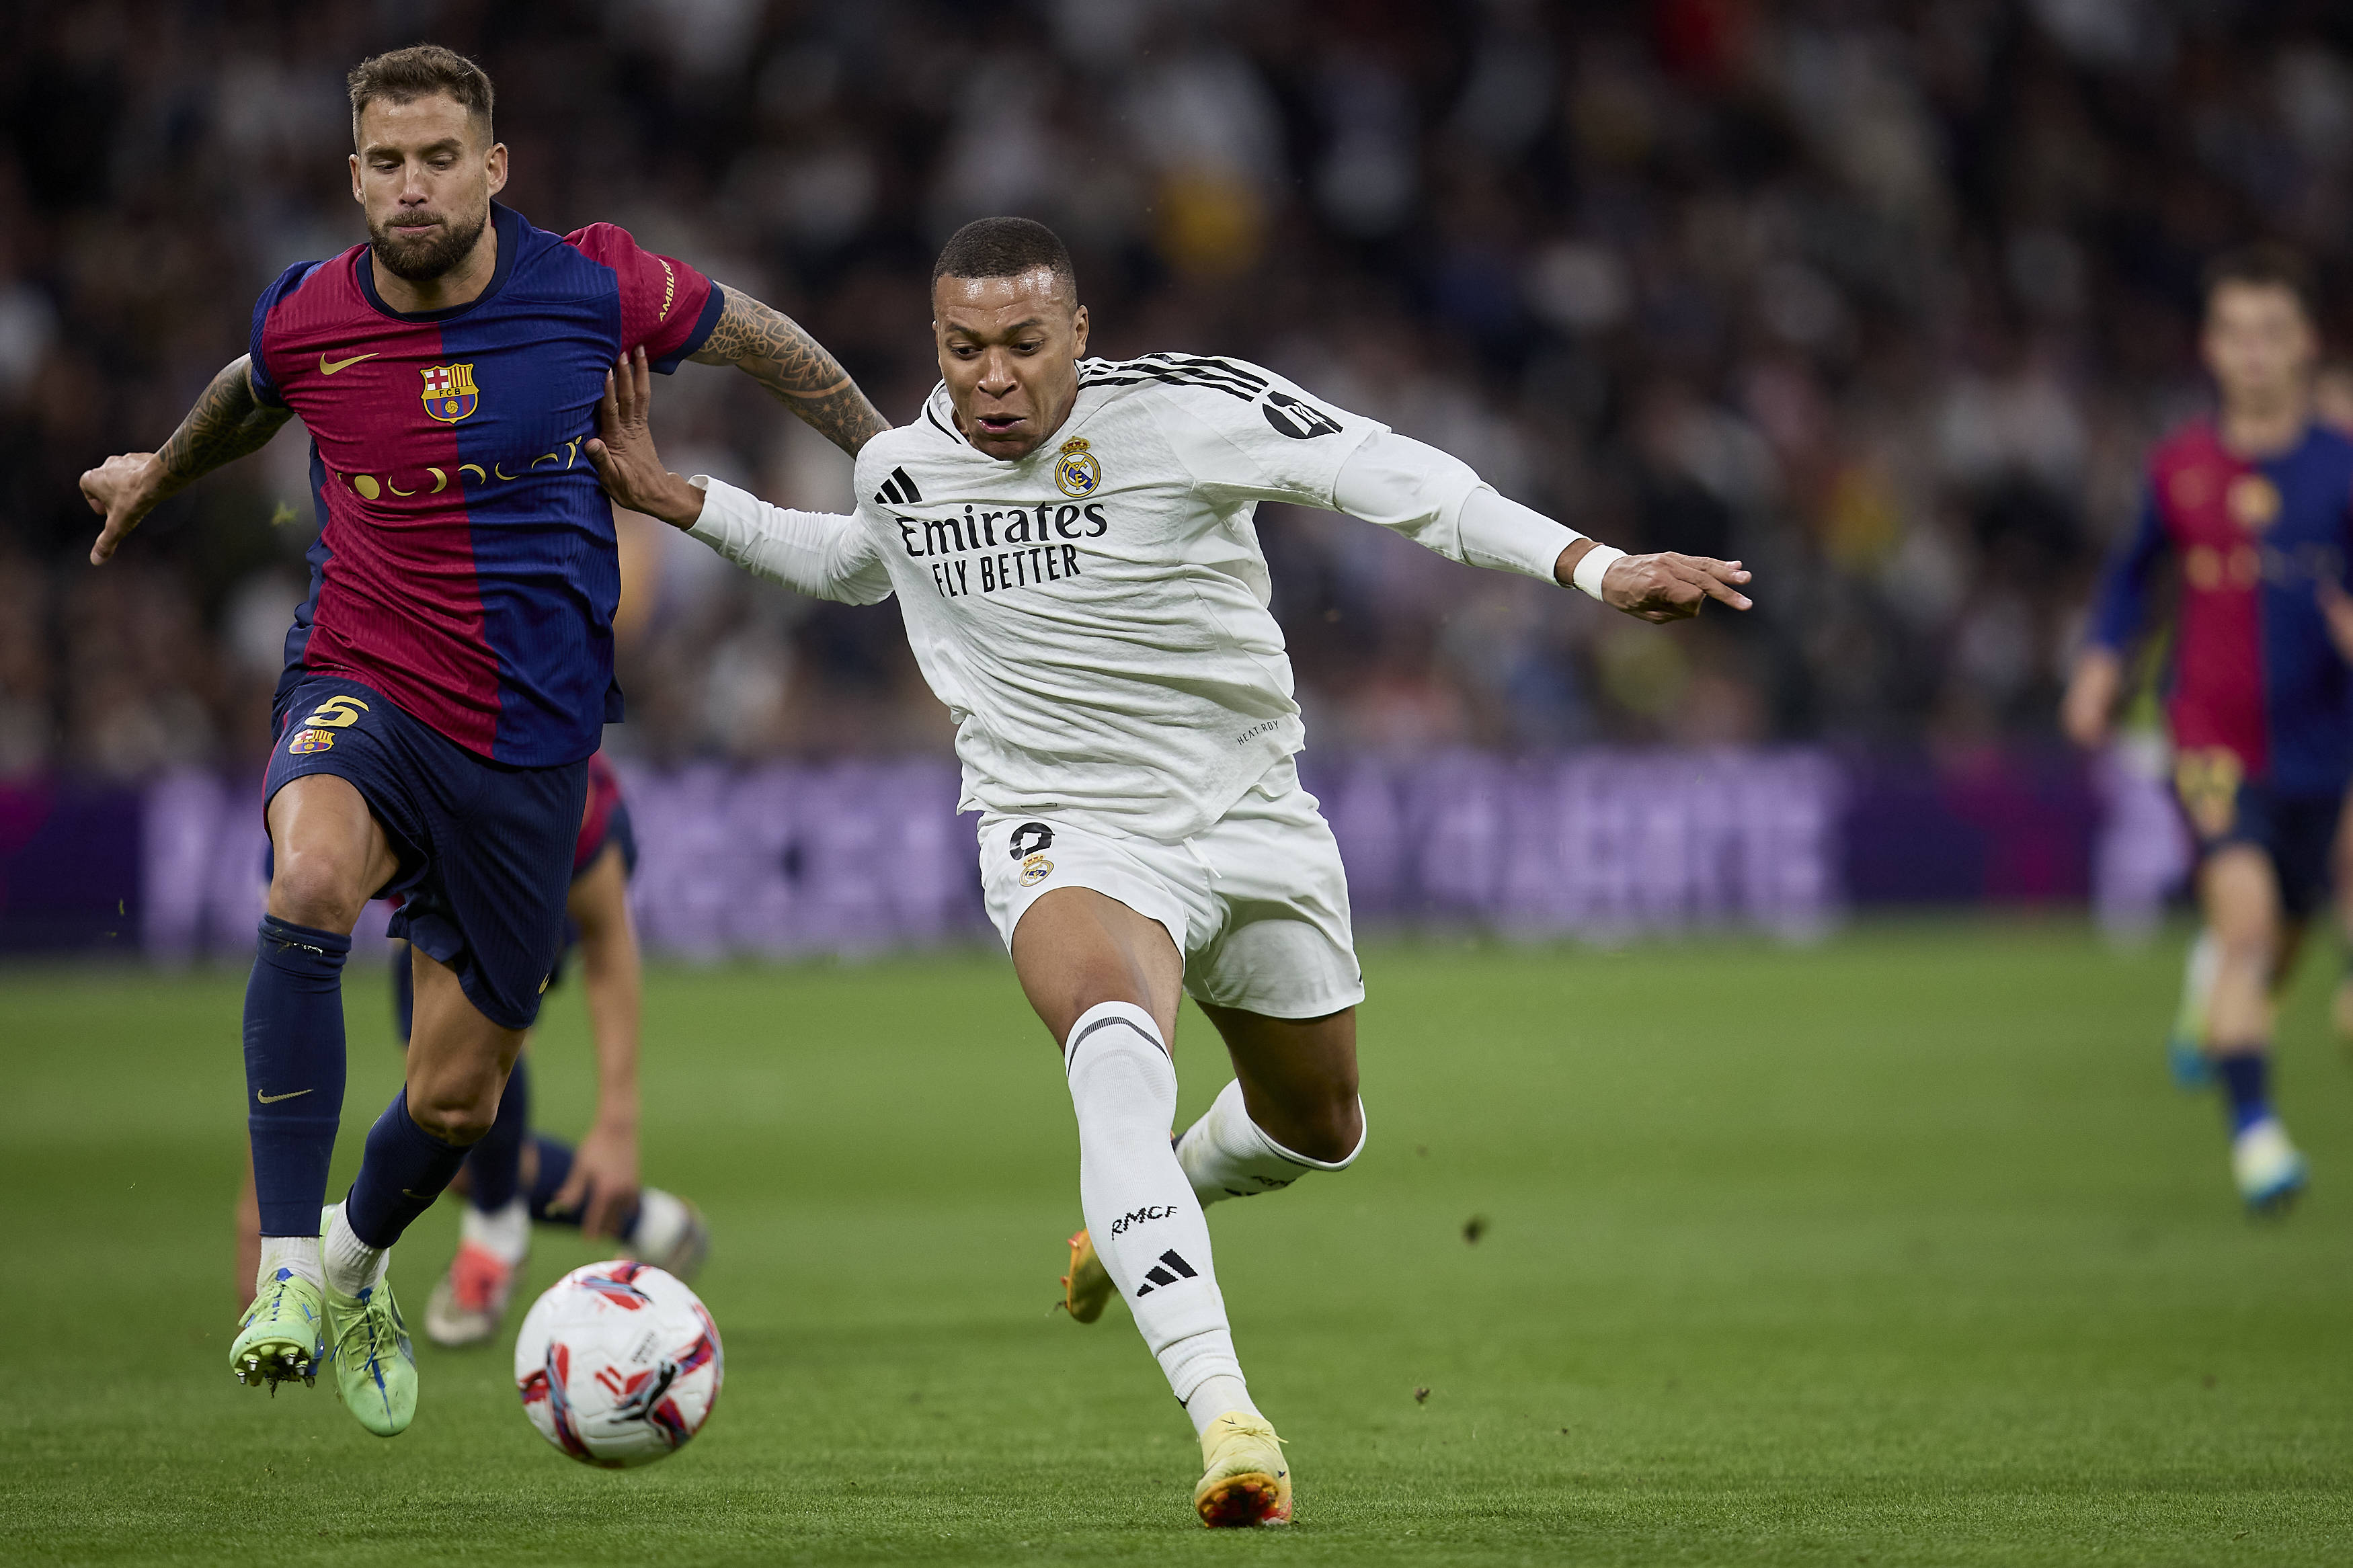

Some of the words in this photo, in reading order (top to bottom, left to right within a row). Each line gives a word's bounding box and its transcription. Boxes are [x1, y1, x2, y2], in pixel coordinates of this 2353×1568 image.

[895, 501, 1108, 557] Emirates
[932, 560, 968, 597] FLY
[980, 543, 1081, 593] BETTER
[1237, 720, 1279, 745] HEAT.RDY
[1112, 1206, 1177, 1241] RMCF
